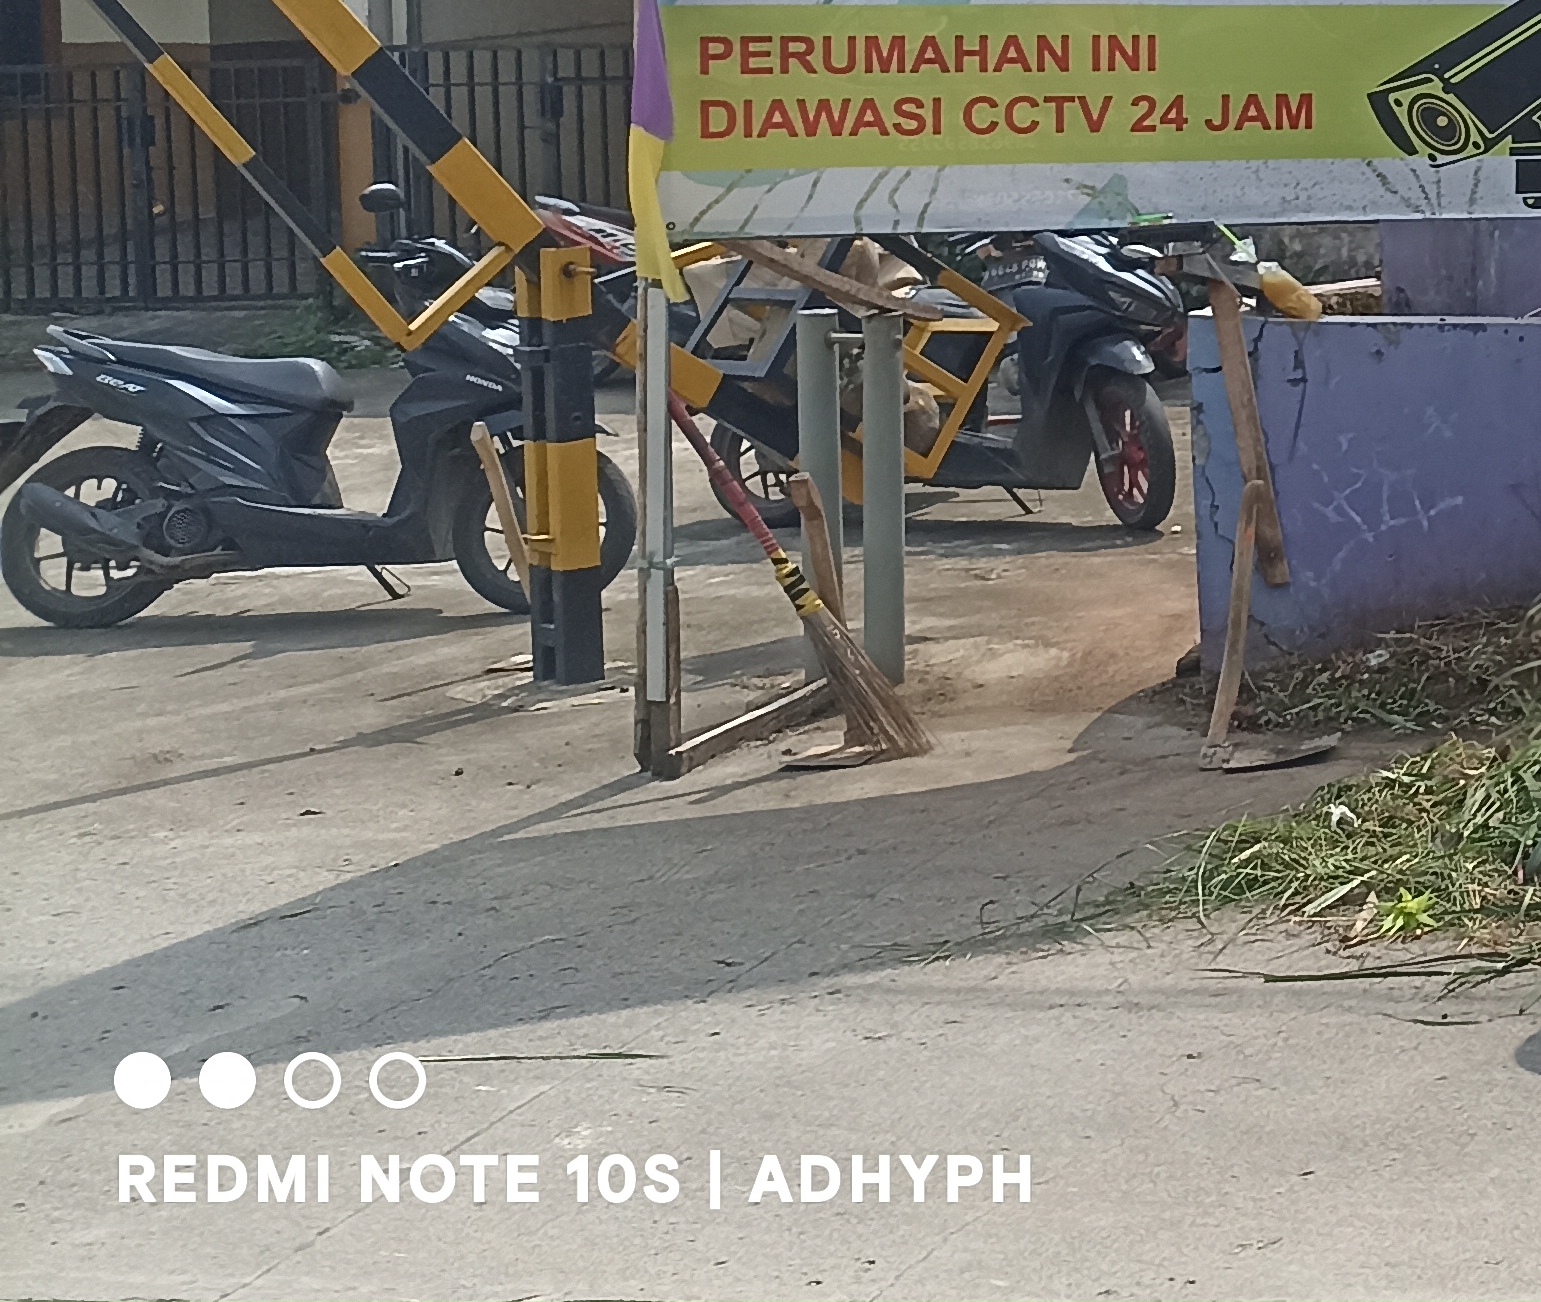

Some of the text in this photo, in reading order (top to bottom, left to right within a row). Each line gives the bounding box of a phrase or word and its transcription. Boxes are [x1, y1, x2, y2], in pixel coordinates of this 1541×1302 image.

[700, 35, 1157, 75] PERUMAHAN INI
[700, 93, 1314, 139] DIAWASI CCTV 24 JAM
